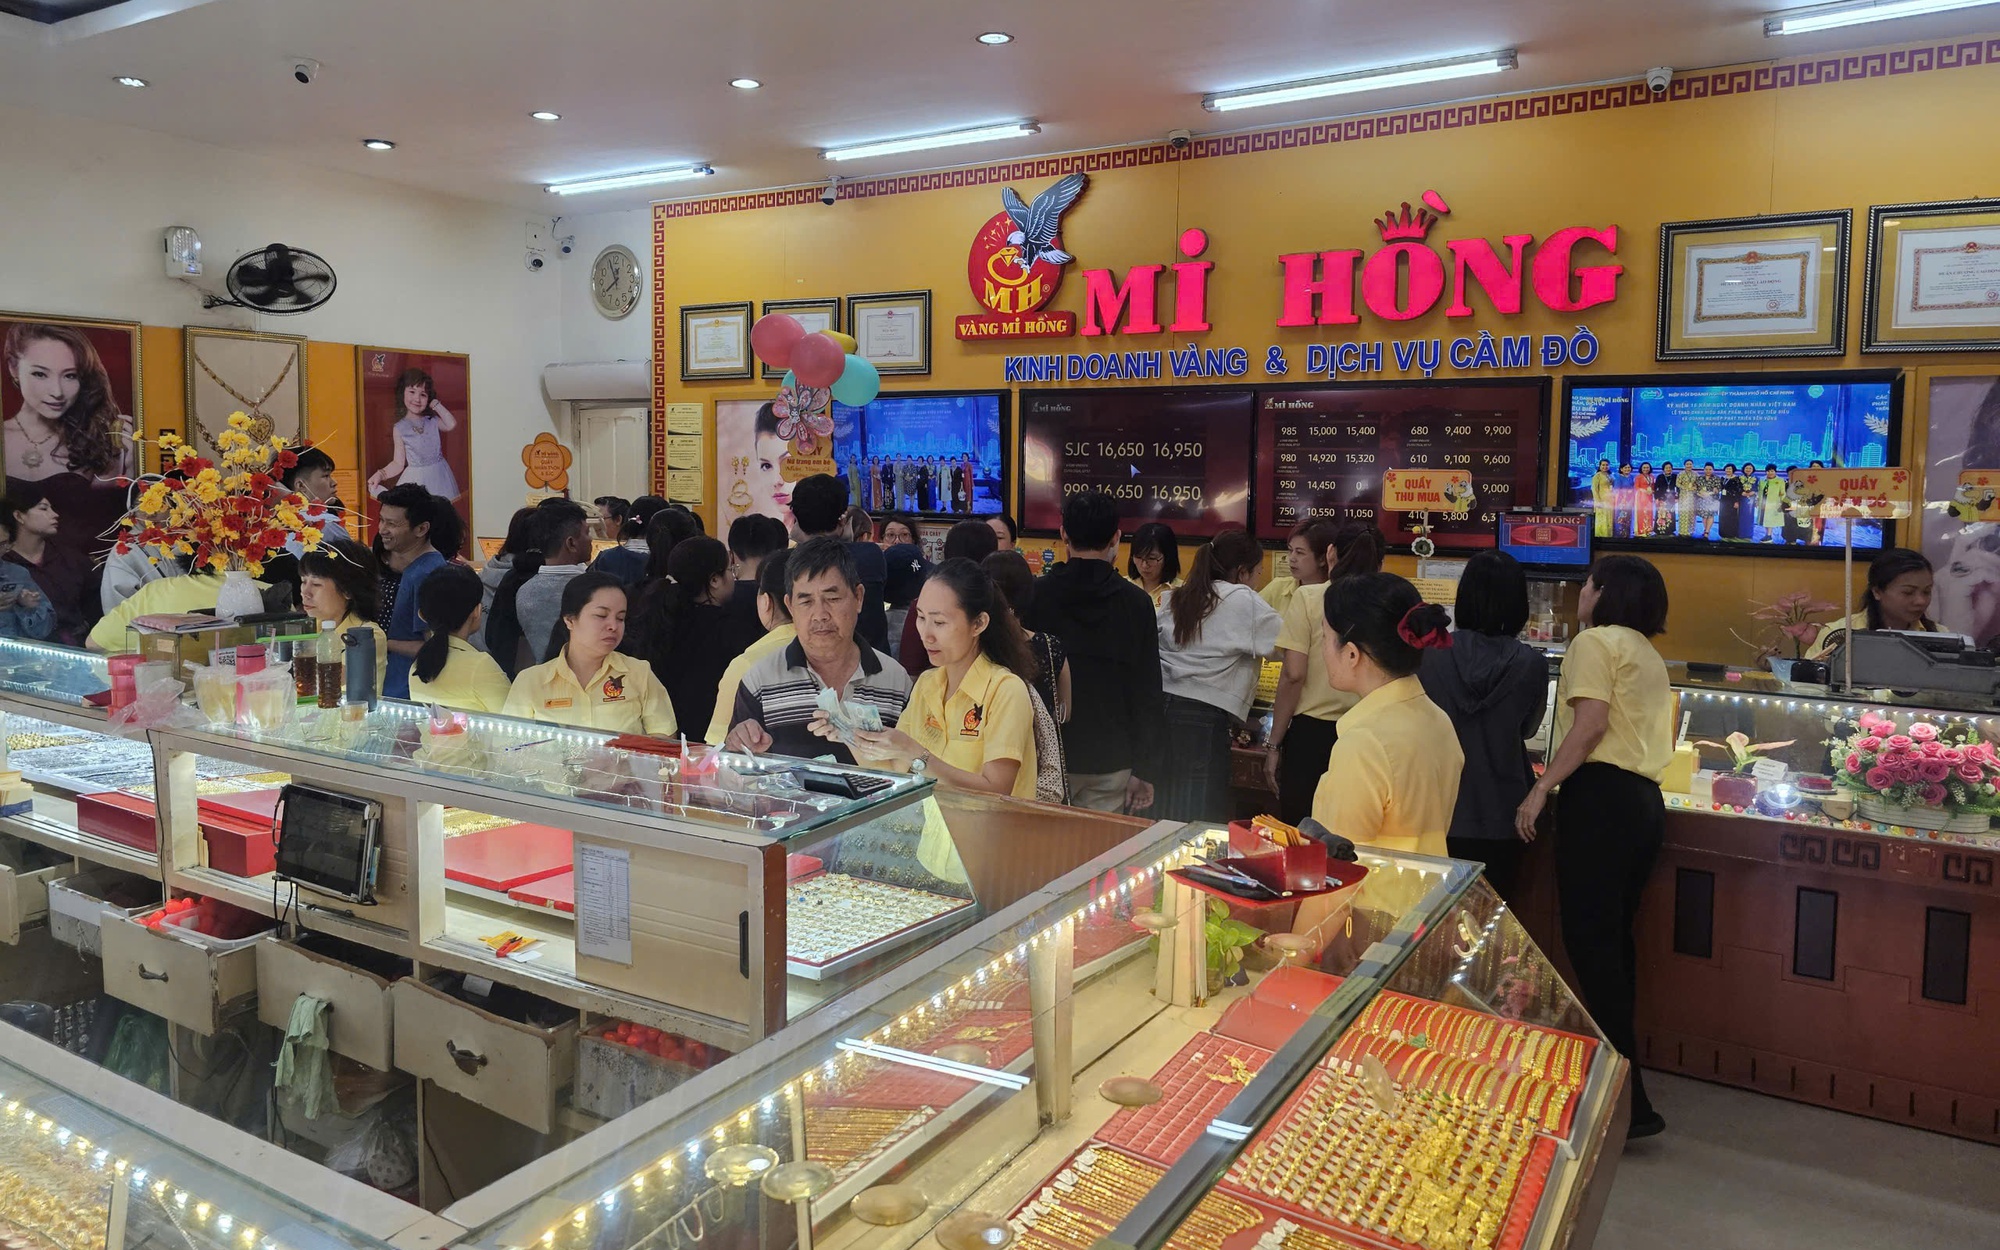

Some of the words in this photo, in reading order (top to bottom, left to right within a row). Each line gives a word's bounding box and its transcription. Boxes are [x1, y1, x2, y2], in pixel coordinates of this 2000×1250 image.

[1276, 189, 1625, 328] HỒNG
[984, 274, 1043, 313] MH
[959, 318, 998, 335] VÀNG
[1025, 313, 1067, 333] HỒNG
[1005, 355, 1062, 382] KINH
[1066, 351, 1161, 380] DOANH
[1169, 343, 1248, 377] VÀNG
[1264, 345, 1288, 374] &
[1307, 342, 1383, 379] DỊCH
[1392, 339, 1441, 377] VỤ
[1449, 330, 1531, 369] CẦM
[1541, 325, 1599, 367] ĐỒ
[1281, 427, 1297, 435] 985
[1308, 427, 1337, 436] 15,000
[1346, 427, 1376, 436] 15,400
[1411, 426, 1429, 435] 680
[1445, 426, 1471, 436] 9,400
[1484, 426, 1511, 436] 9,900
[1065, 442, 1090, 456] SJC
[1097, 442, 1144, 459] 16,650
[1152, 442, 1203, 459] 16,950
[1280, 454, 1296, 462] 980
[1308, 454, 1336, 463] 14,920
[1345, 454, 1375, 464] 15,320
[1410, 455, 1428, 463] 610
[1444, 455, 1470, 465] 9,100
[1483, 455, 1510, 465] 9,600
[1152, 485, 1201, 501] 16,950
[1280, 480, 1296, 489] 950
[1307, 481, 1336, 490] 14,450
[1482, 484, 1509, 494] 9,000
[1395, 492, 1416, 502] THU
[1418, 492, 1440, 502] MUA
[1280, 507, 1295, 515] 750
[1306, 508, 1335, 517] 10,550
[1344, 509, 1373, 518] 11,050
[1442, 512, 1468, 521] 5,800
